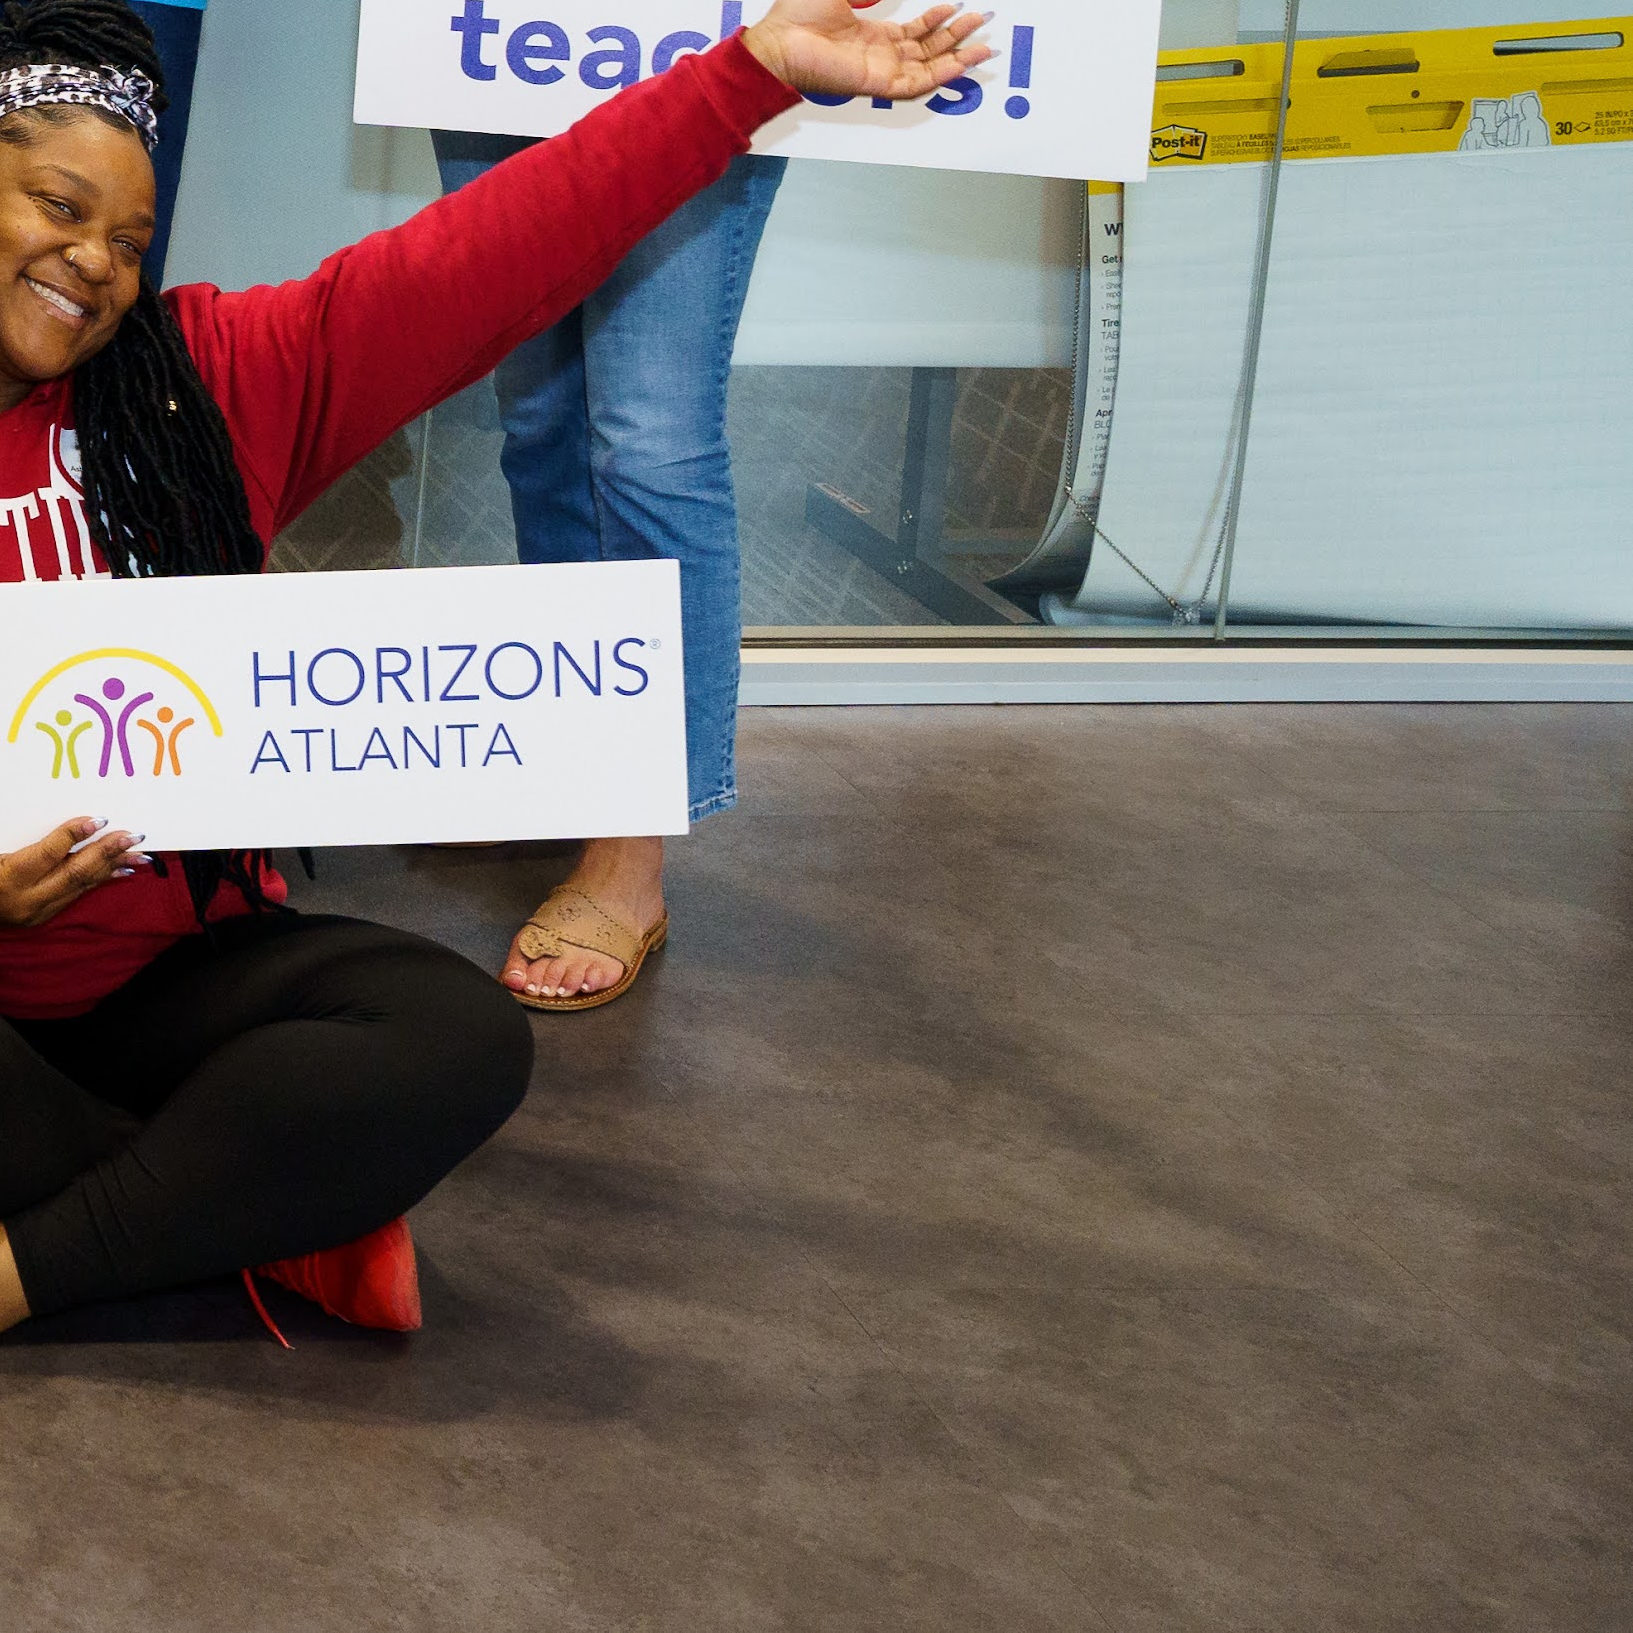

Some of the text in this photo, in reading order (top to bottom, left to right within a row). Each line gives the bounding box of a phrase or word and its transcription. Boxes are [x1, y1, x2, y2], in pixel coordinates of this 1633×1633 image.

[1555, 122, 1572, 135] 30
[1152, 134, 1200, 148] Post-it
[1101, 254, 1118, 265] Get
[250, 723, 523, 774] ATLANTA
